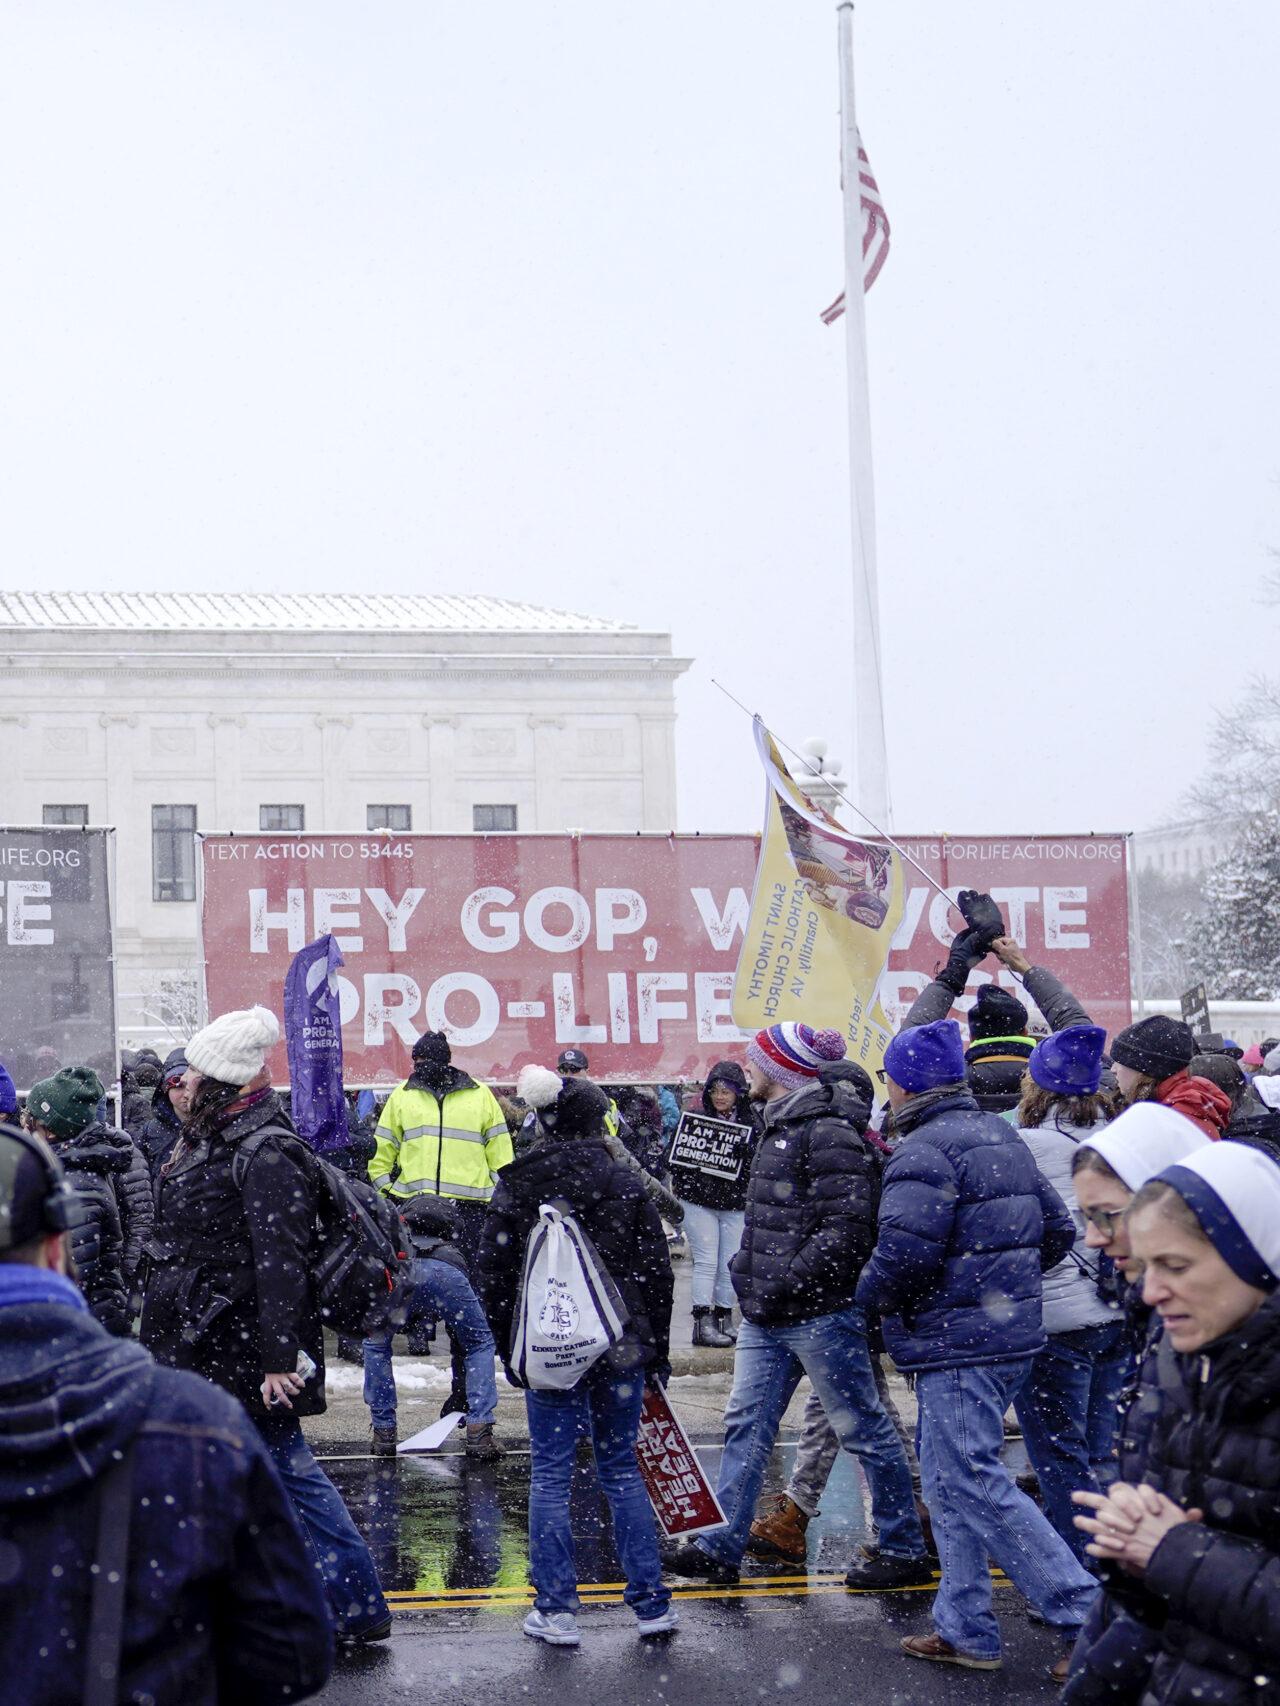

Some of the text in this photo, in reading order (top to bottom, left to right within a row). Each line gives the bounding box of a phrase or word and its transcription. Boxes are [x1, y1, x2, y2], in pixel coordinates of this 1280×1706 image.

[209, 842, 414, 860] TEXT ACTION TO 53445
[898, 843, 1123, 860] NTSFORLIFEACTION.ORG
[249, 887, 427, 954] HEY
[460, 886, 659, 962] GOP,
[690, 887, 752, 952] W
[677, 1133, 734, 1156] PRO-LIF
[684, 1124, 742, 1144] I AM THE
[676, 1146, 738, 1169] GENERATION
[563, 1338, 597, 1352] CATHOLIC
[653, 1417, 702, 1494] BEAT
[654, 1478, 680, 1516] LET
